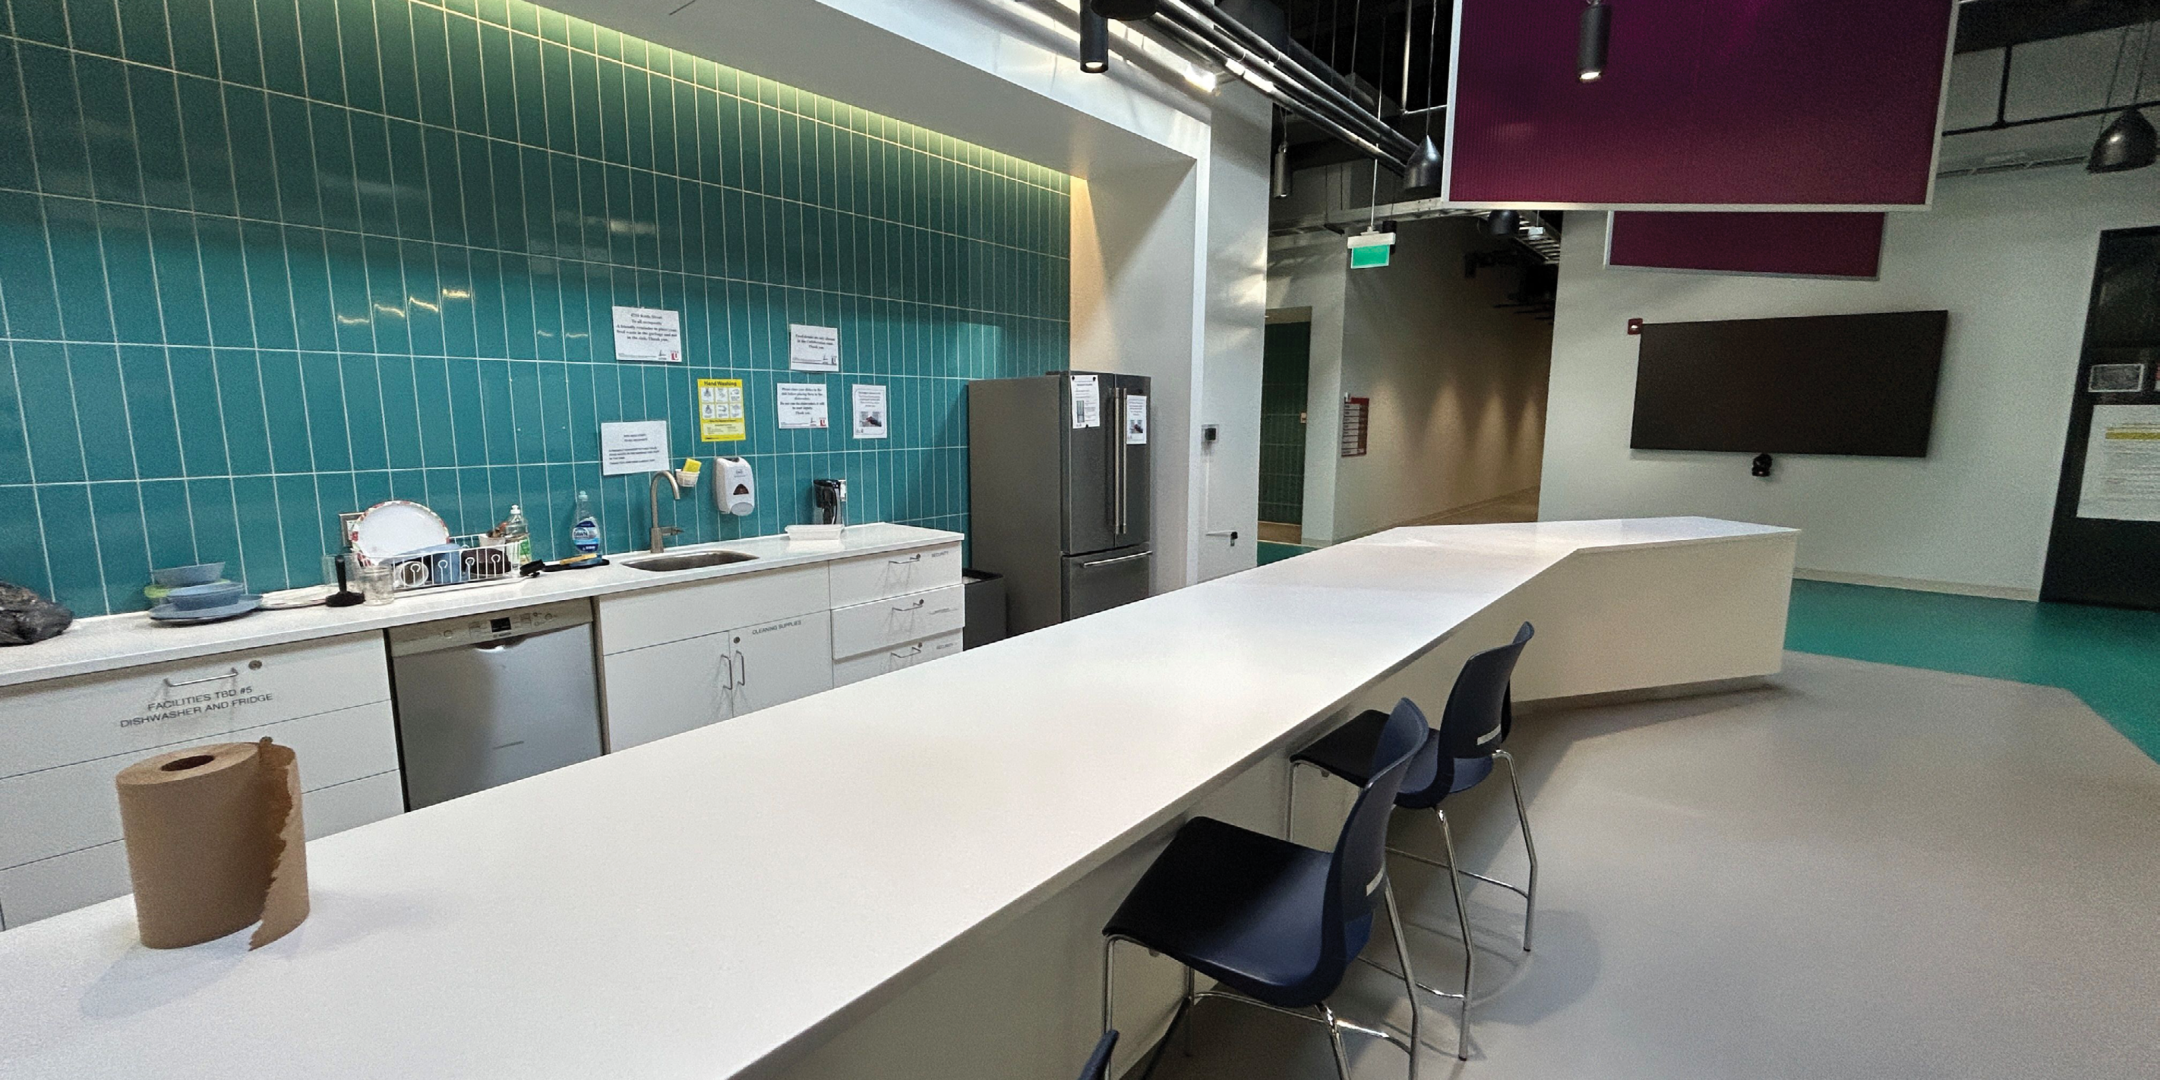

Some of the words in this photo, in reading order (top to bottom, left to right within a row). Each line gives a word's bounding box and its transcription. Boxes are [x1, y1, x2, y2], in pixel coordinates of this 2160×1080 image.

[752, 625, 778, 634] CLEANING
[778, 620, 801, 629] SUPPLIES
[120, 706, 202, 728] DISHWASHER
[205, 701, 229, 712] AND
[232, 693, 273, 708] FRIDGE
[148, 693, 212, 711] FACILITIES
[215, 689, 237, 700] TBD
[240, 686, 253, 695] #5
